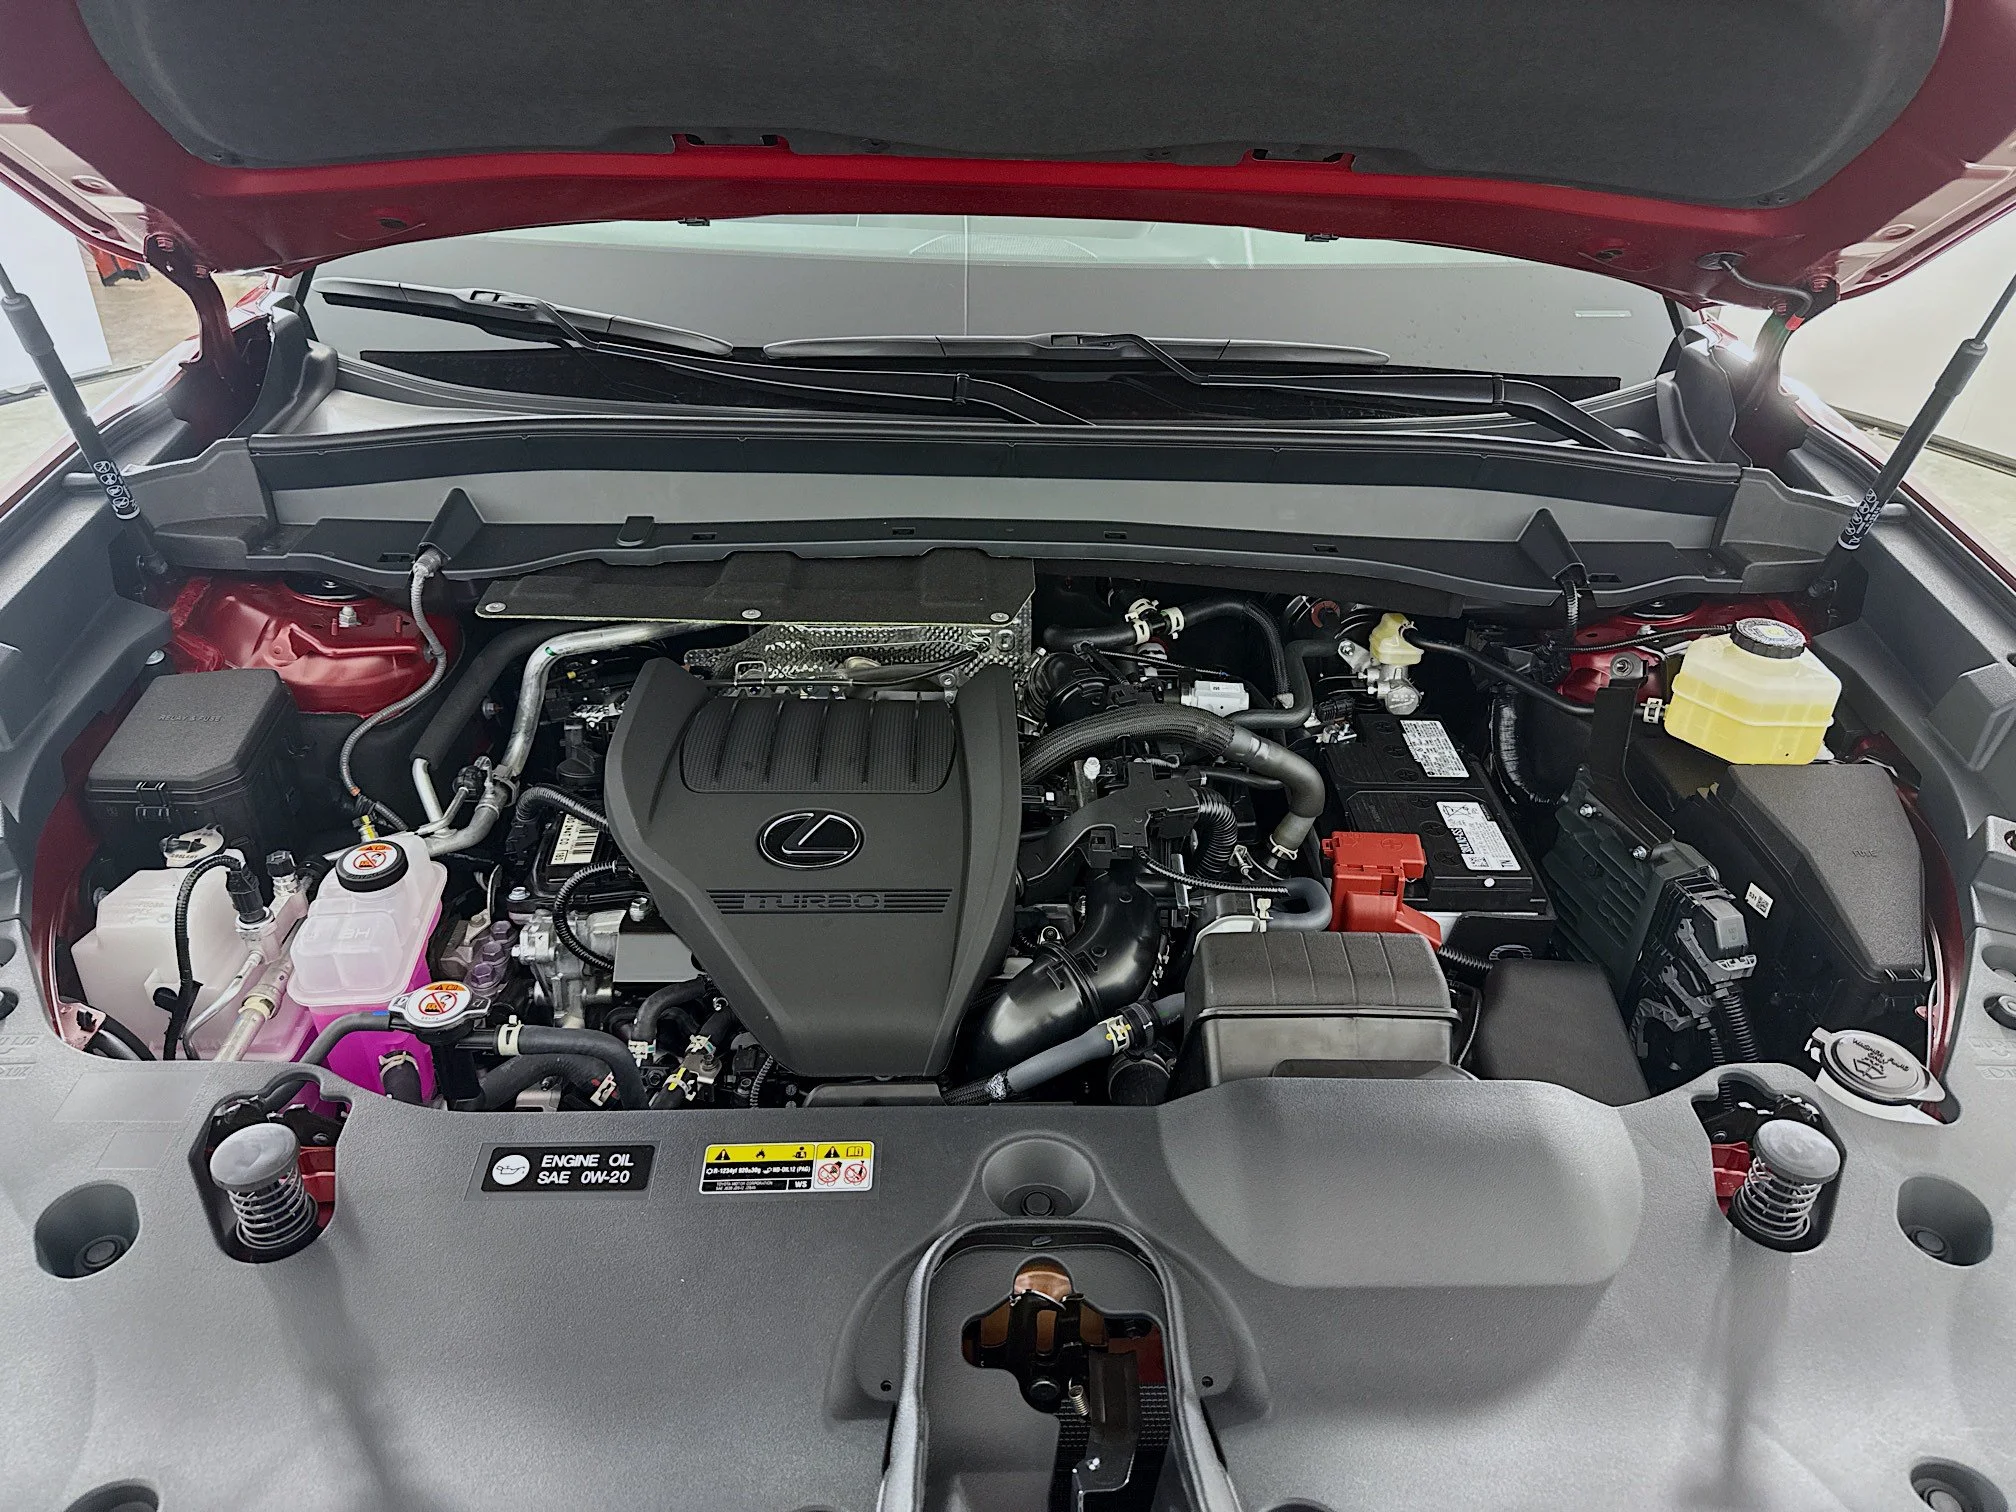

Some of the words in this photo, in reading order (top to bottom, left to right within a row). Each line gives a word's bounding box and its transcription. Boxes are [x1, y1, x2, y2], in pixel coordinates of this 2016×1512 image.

[749, 894, 880, 908] TURBO
[541, 1154, 600, 1168] ENGINE
[608, 1153, 635, 1167] OIL
[536, 1170, 571, 1185] SAE
[580, 1170, 631, 1184] 0W-20
[794, 1180, 808, 1189] WS
